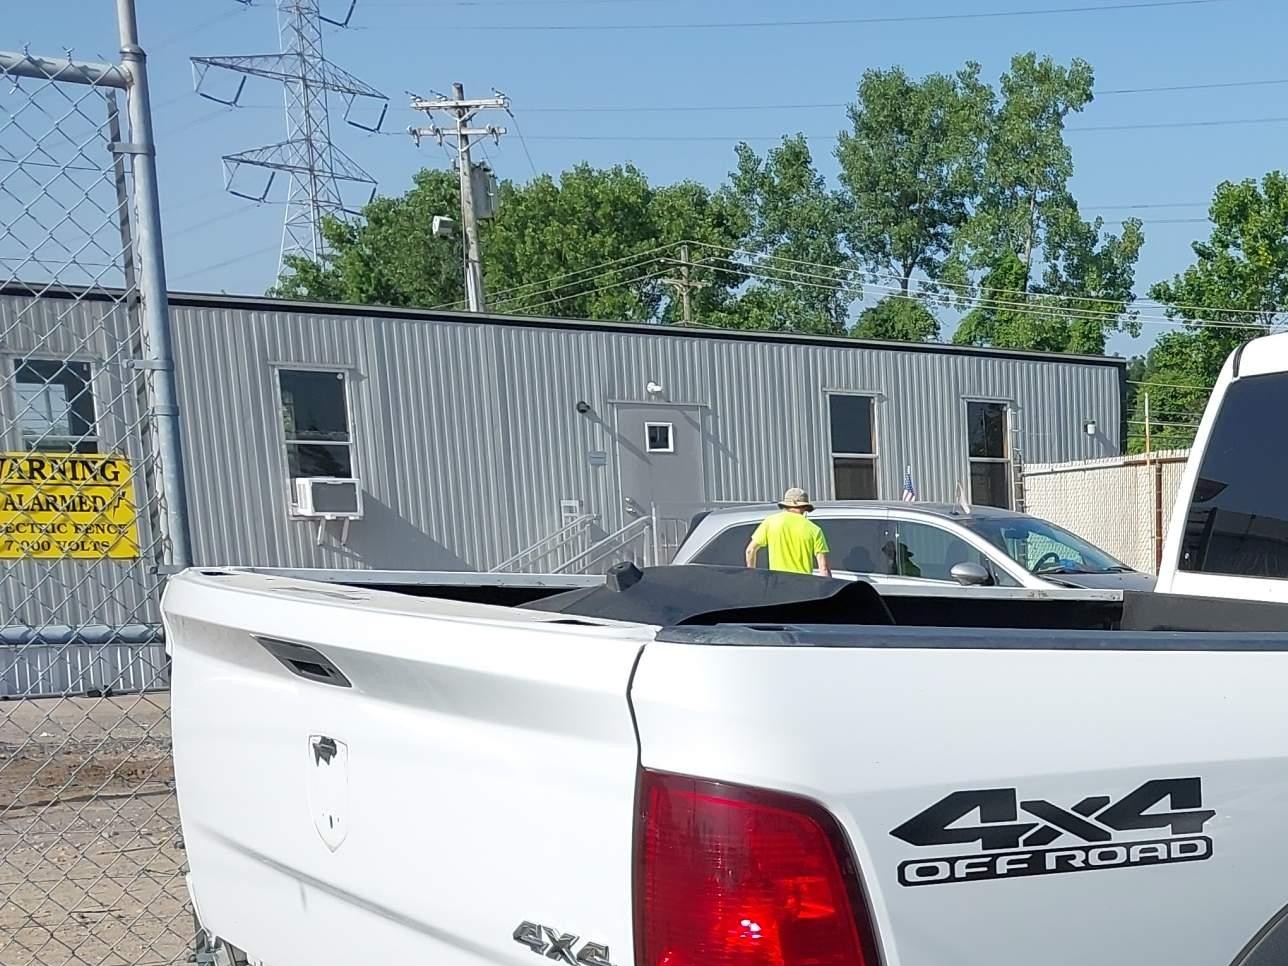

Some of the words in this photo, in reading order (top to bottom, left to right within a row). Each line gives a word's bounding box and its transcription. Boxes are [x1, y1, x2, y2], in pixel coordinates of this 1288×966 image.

[3, 494, 106, 513] ALARMED
[74, 523, 129, 535] FENCE
[56, 540, 110, 554] VOLTS
[903, 853, 1033, 883] OFF
[1045, 842, 1207, 870] ROAD
